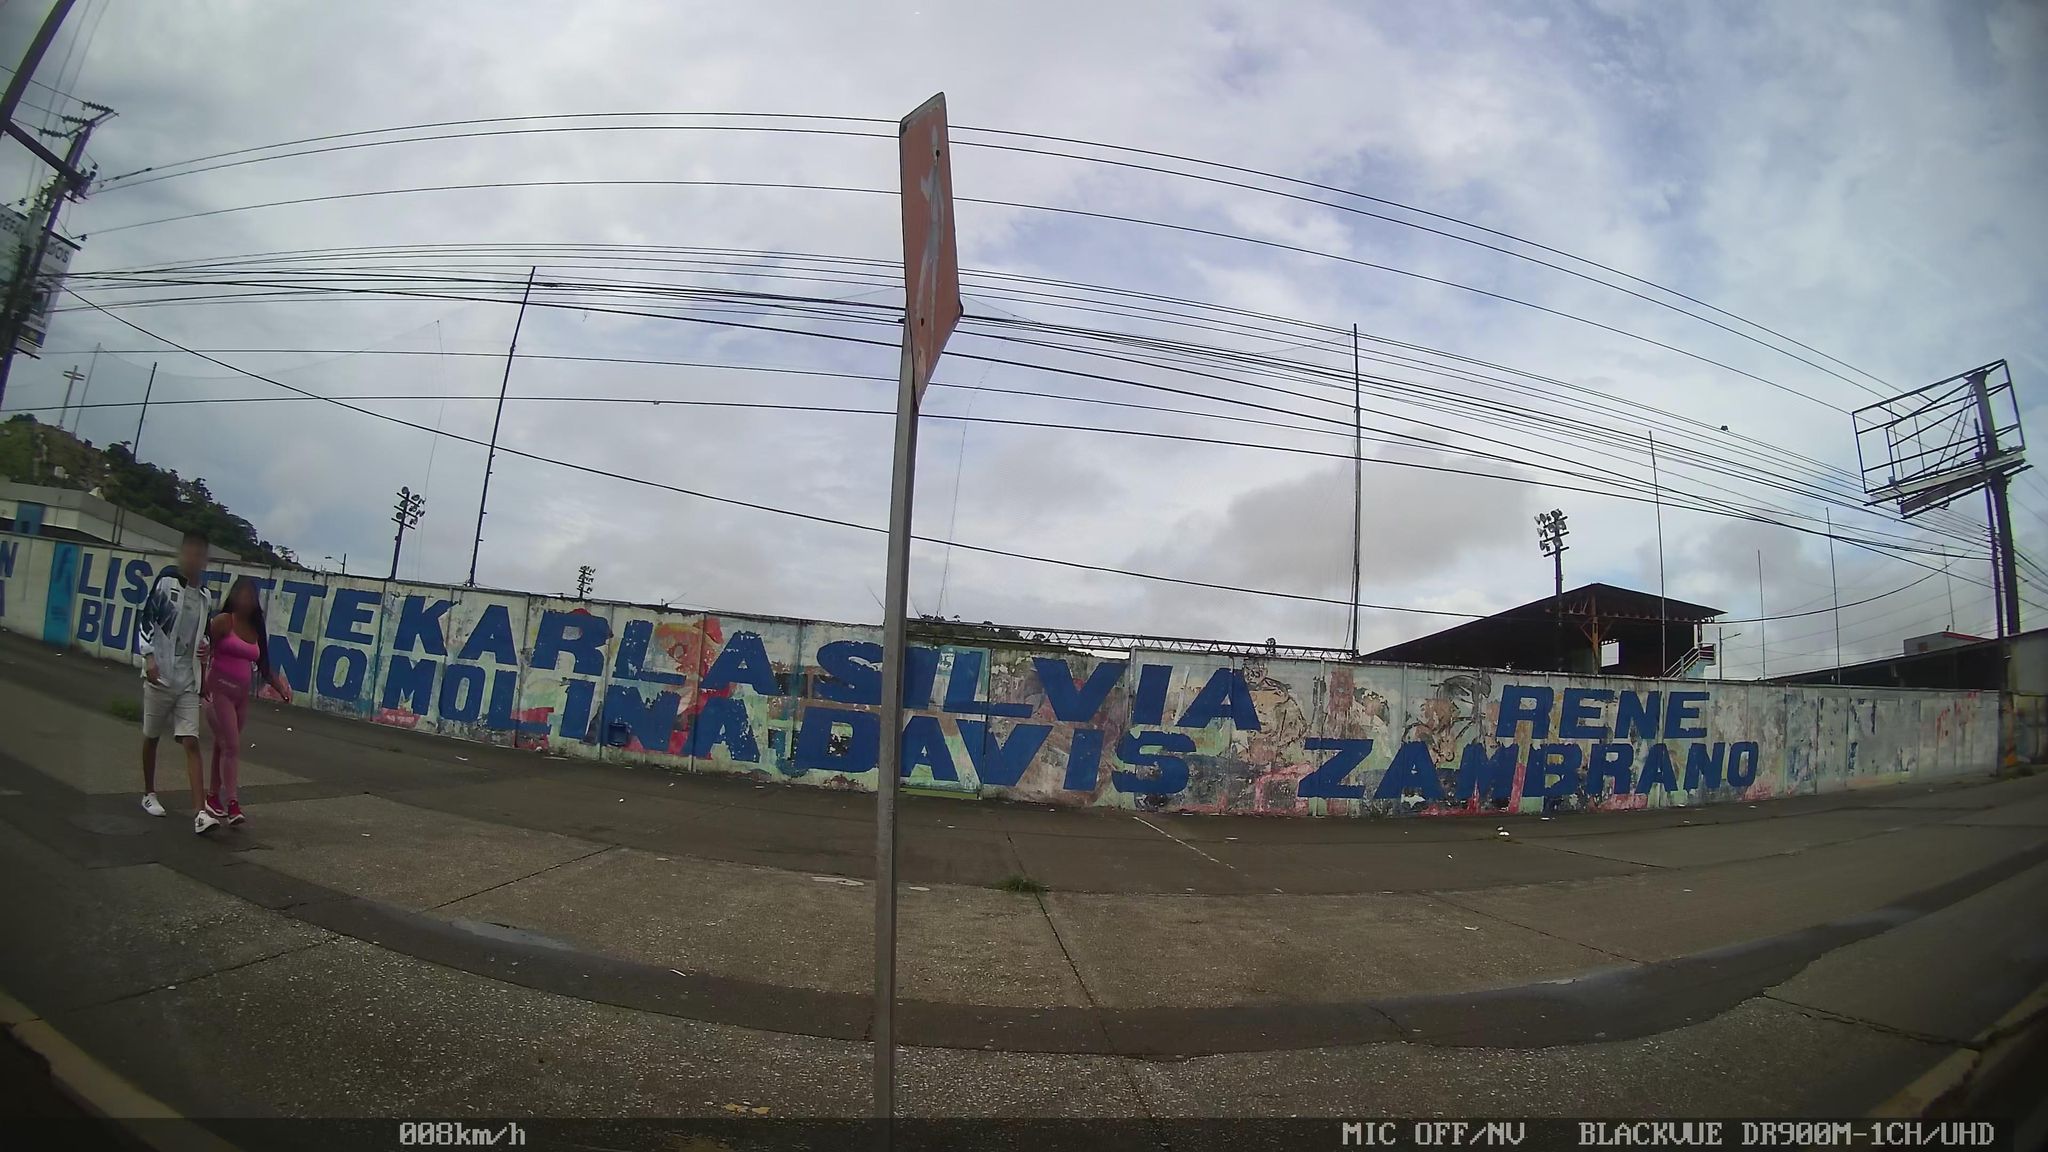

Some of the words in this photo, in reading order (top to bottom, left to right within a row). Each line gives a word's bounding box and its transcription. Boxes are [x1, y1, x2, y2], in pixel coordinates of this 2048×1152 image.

[77, 552, 382, 645] LISETE
[75, 597, 368, 699] BUNO
[393, 594, 782, 696] KARLA
[813, 640, 1261, 731] SILVIA
[381, 654, 761, 763] MOLINA
[797, 706, 1197, 794] DAVIS
[1496, 684, 1711, 740] RENE
[1298, 738, 1760, 799] ZAMBRANO
